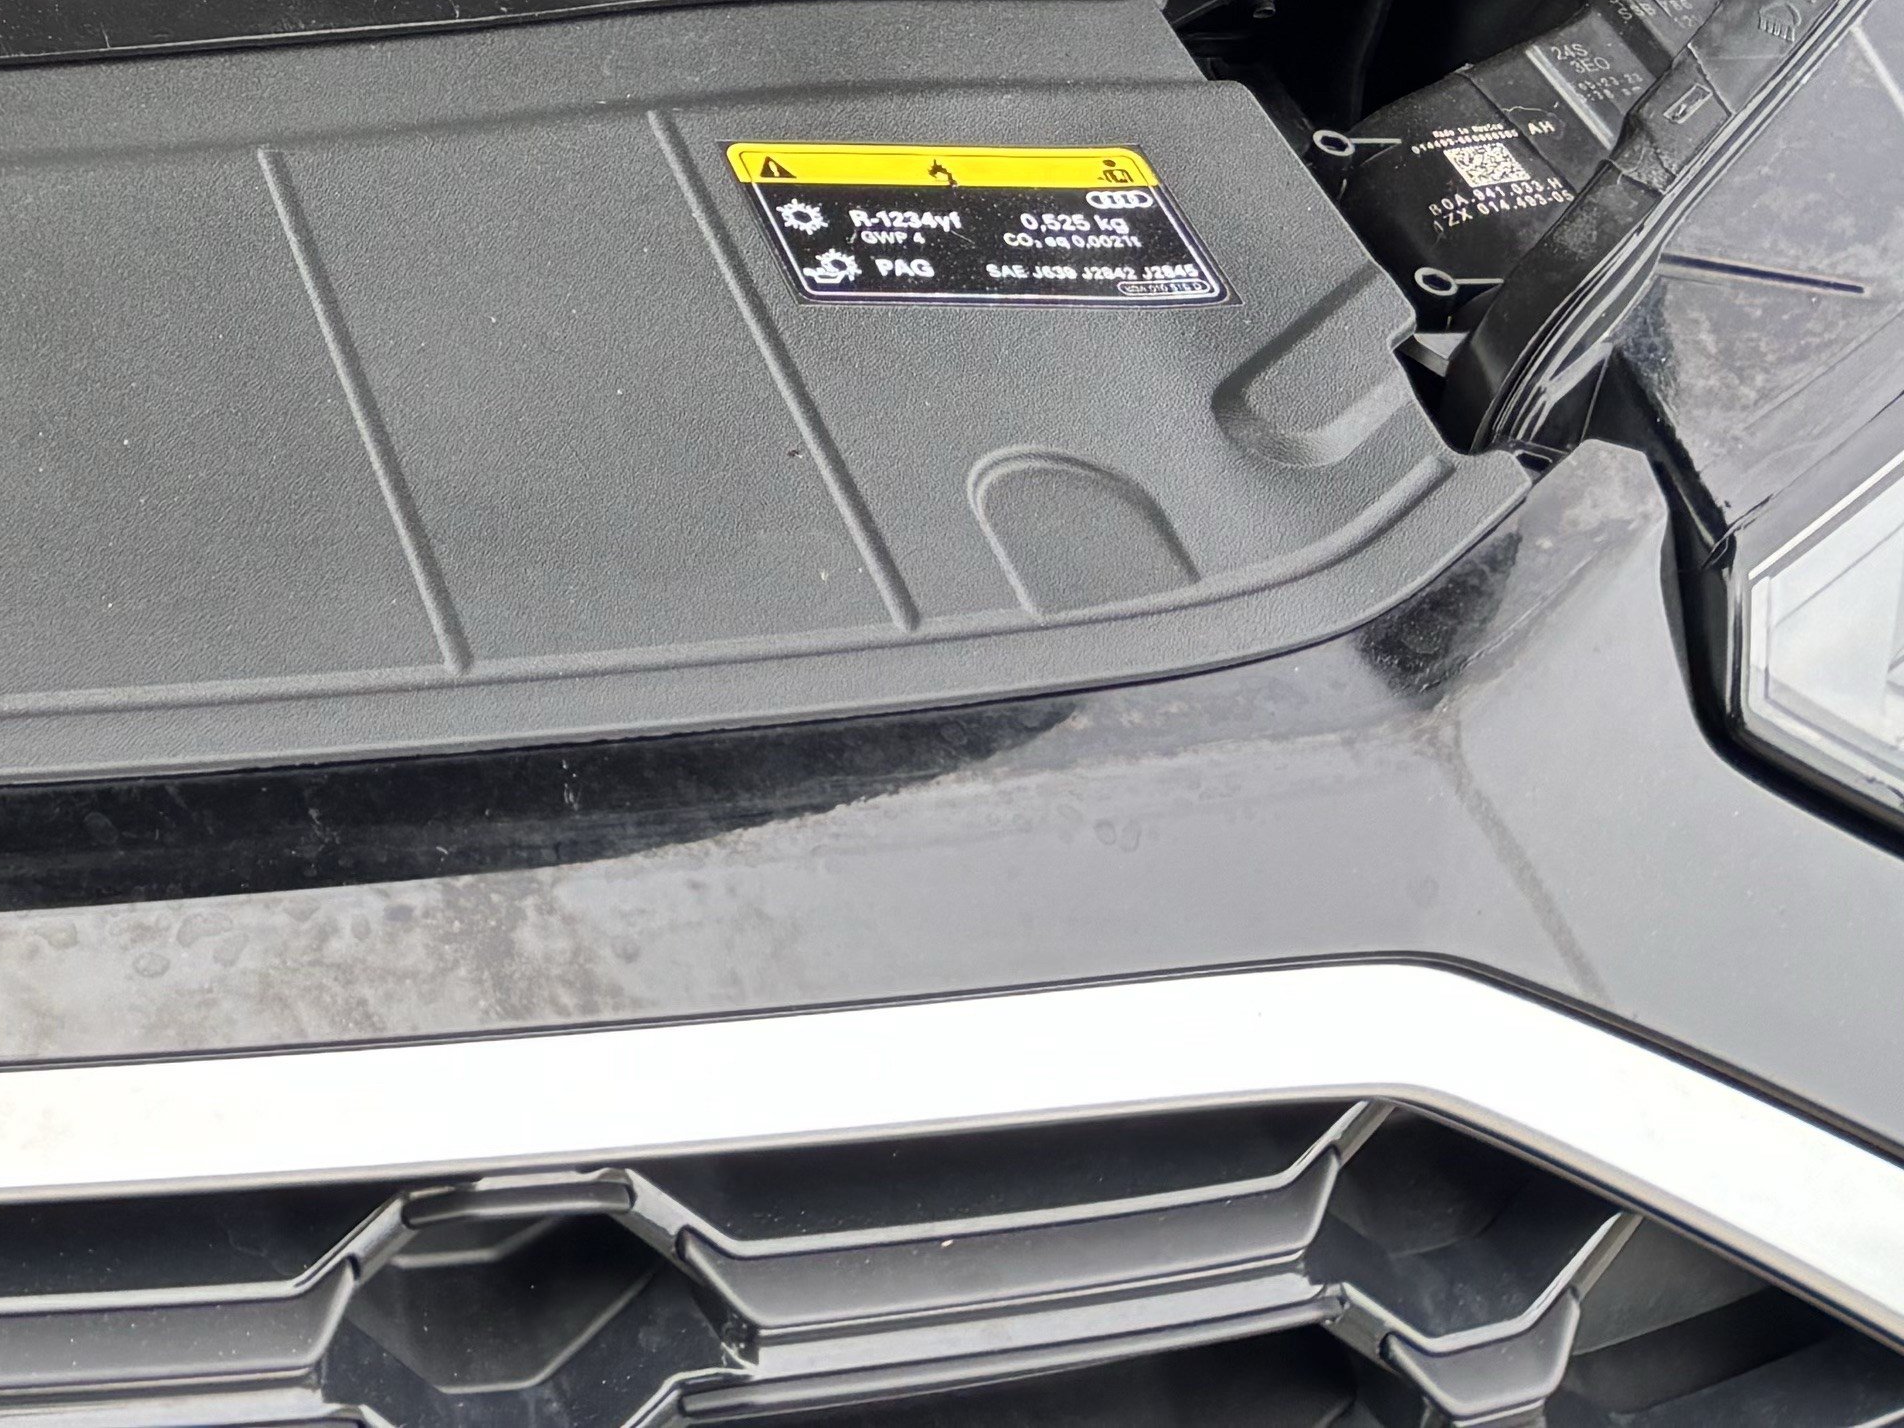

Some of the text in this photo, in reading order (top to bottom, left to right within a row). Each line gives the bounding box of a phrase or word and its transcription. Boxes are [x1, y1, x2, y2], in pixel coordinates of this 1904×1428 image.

[1432, 123, 1504, 139] Made in Mexico
[1527, 120, 1556, 136] AH
[849, 209, 962, 232] R-1234yf
[1019, 212, 1130, 235] 0,525 kg
[861, 230, 926, 244] GWP 4
[875, 258, 935, 278] PAG
[986, 263, 1199, 281] SAE J639 J2842 J2845
